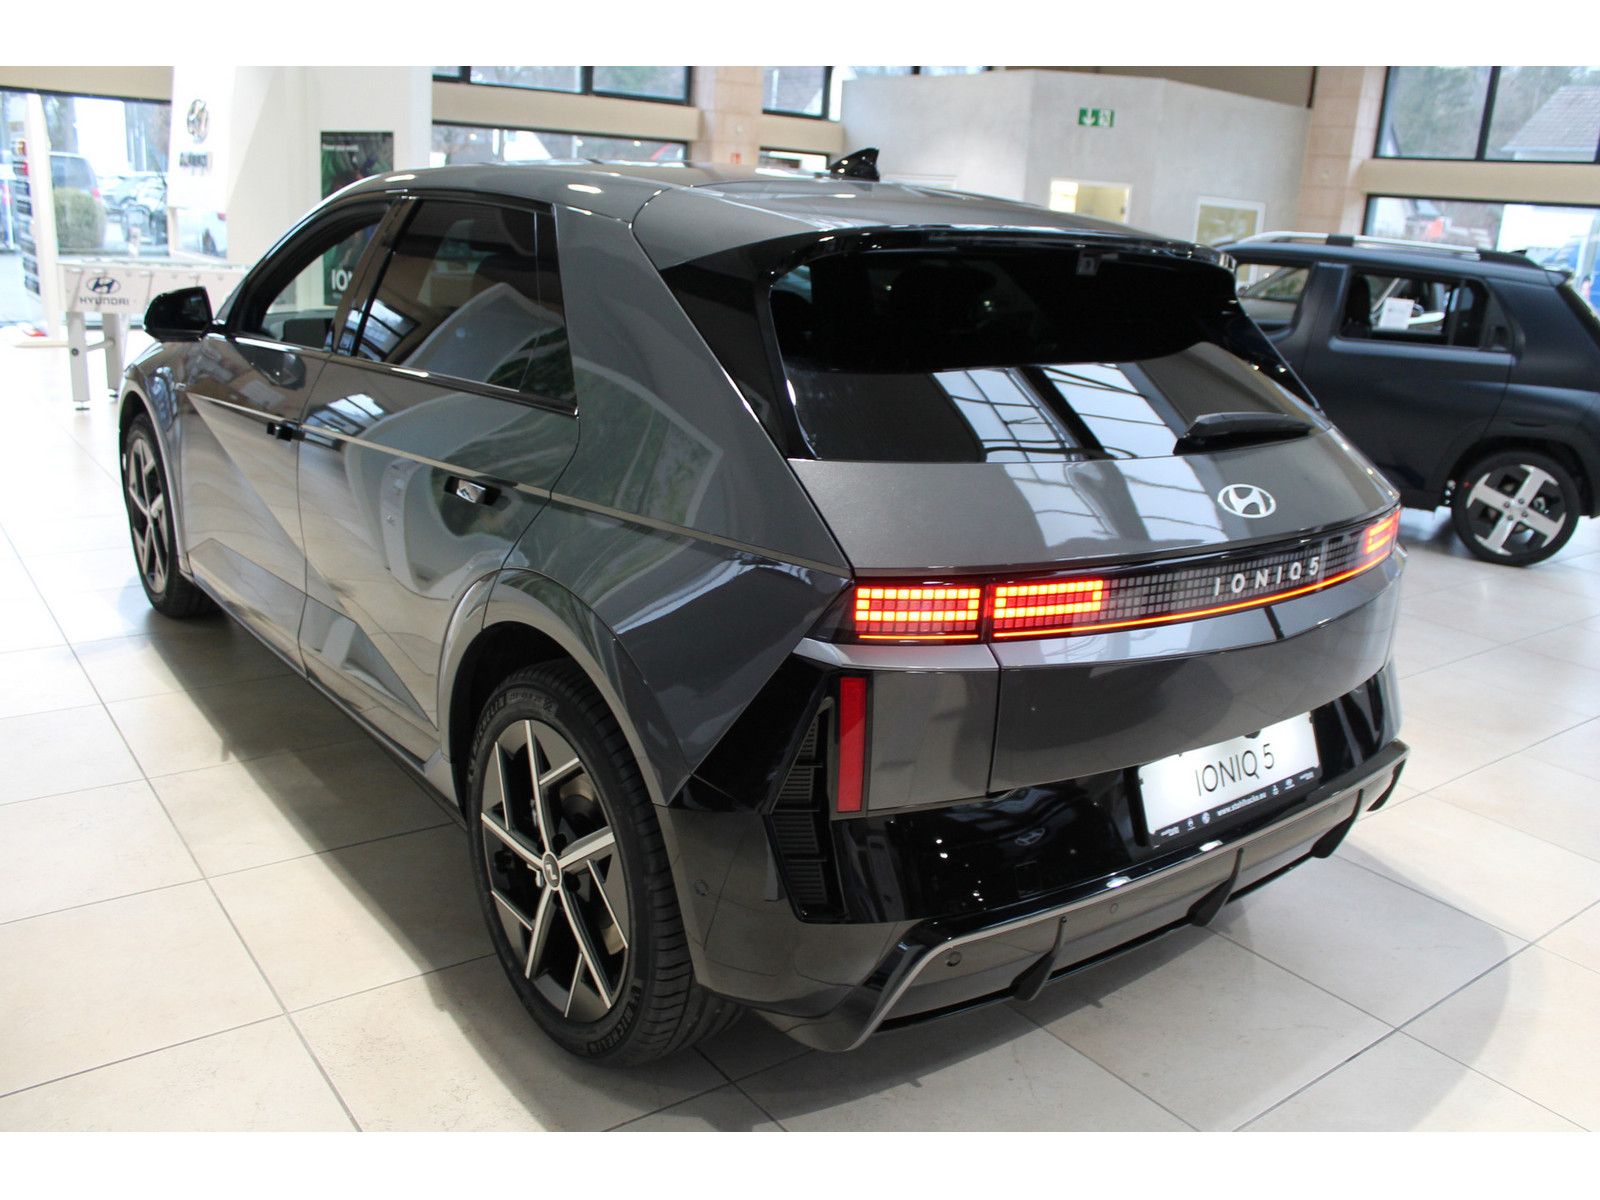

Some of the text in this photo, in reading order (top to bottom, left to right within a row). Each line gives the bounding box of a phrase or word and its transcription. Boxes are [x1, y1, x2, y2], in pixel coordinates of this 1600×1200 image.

[331, 268, 354, 292] IO
[79, 296, 130, 306] HYUNDAI
[1212, 556, 1321, 597] IONIQ 5
[1195, 743, 1276, 798] IONIQ 5
